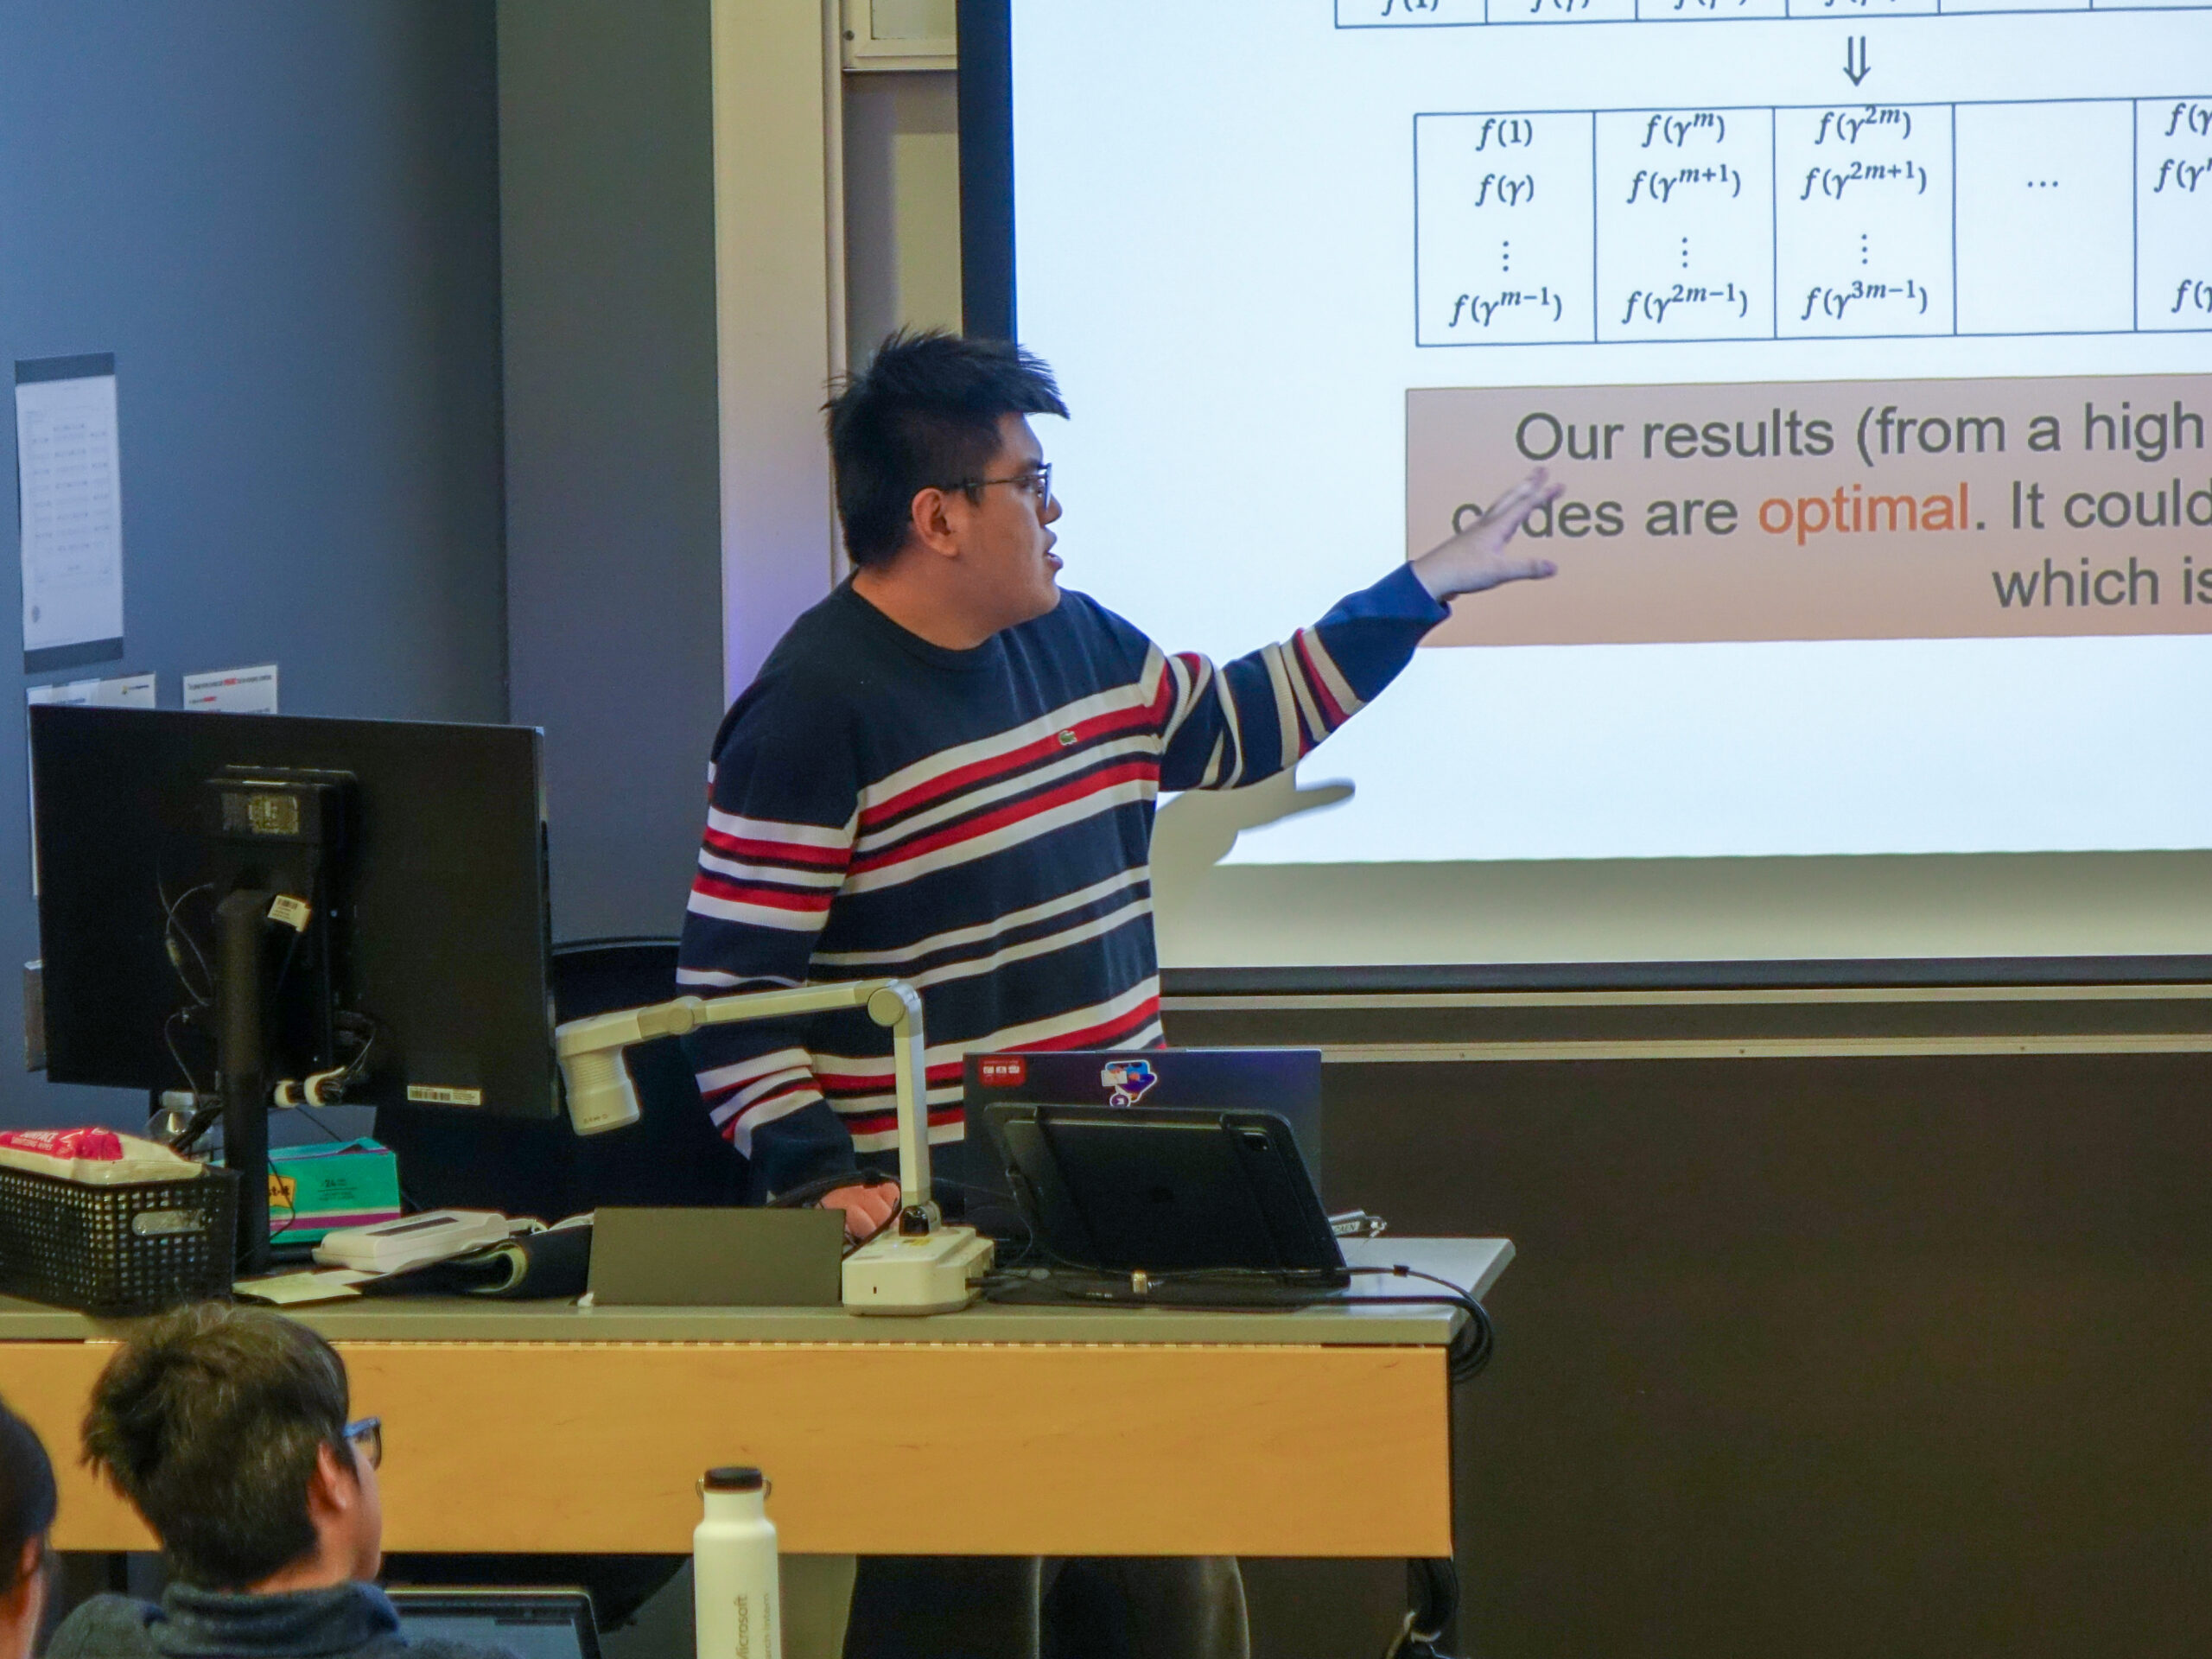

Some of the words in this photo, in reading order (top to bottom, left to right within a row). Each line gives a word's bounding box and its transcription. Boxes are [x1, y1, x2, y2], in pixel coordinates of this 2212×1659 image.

[1475, 118, 1533, 152] f(1)
[1516, 412, 1624, 461] Our
[1643, 407, 1834, 459] results
[1857, 405, 2005, 467] (from
[2027, 415, 2062, 452] a
[2084, 400, 2204, 462] high
[1452, 499, 1624, 538] cdes
[1645, 499, 1738, 537] are
[1758, 481, 1986, 546] optimal.
[2012, 480, 2045, 530] It
[1991, 556, 2159, 607] which
